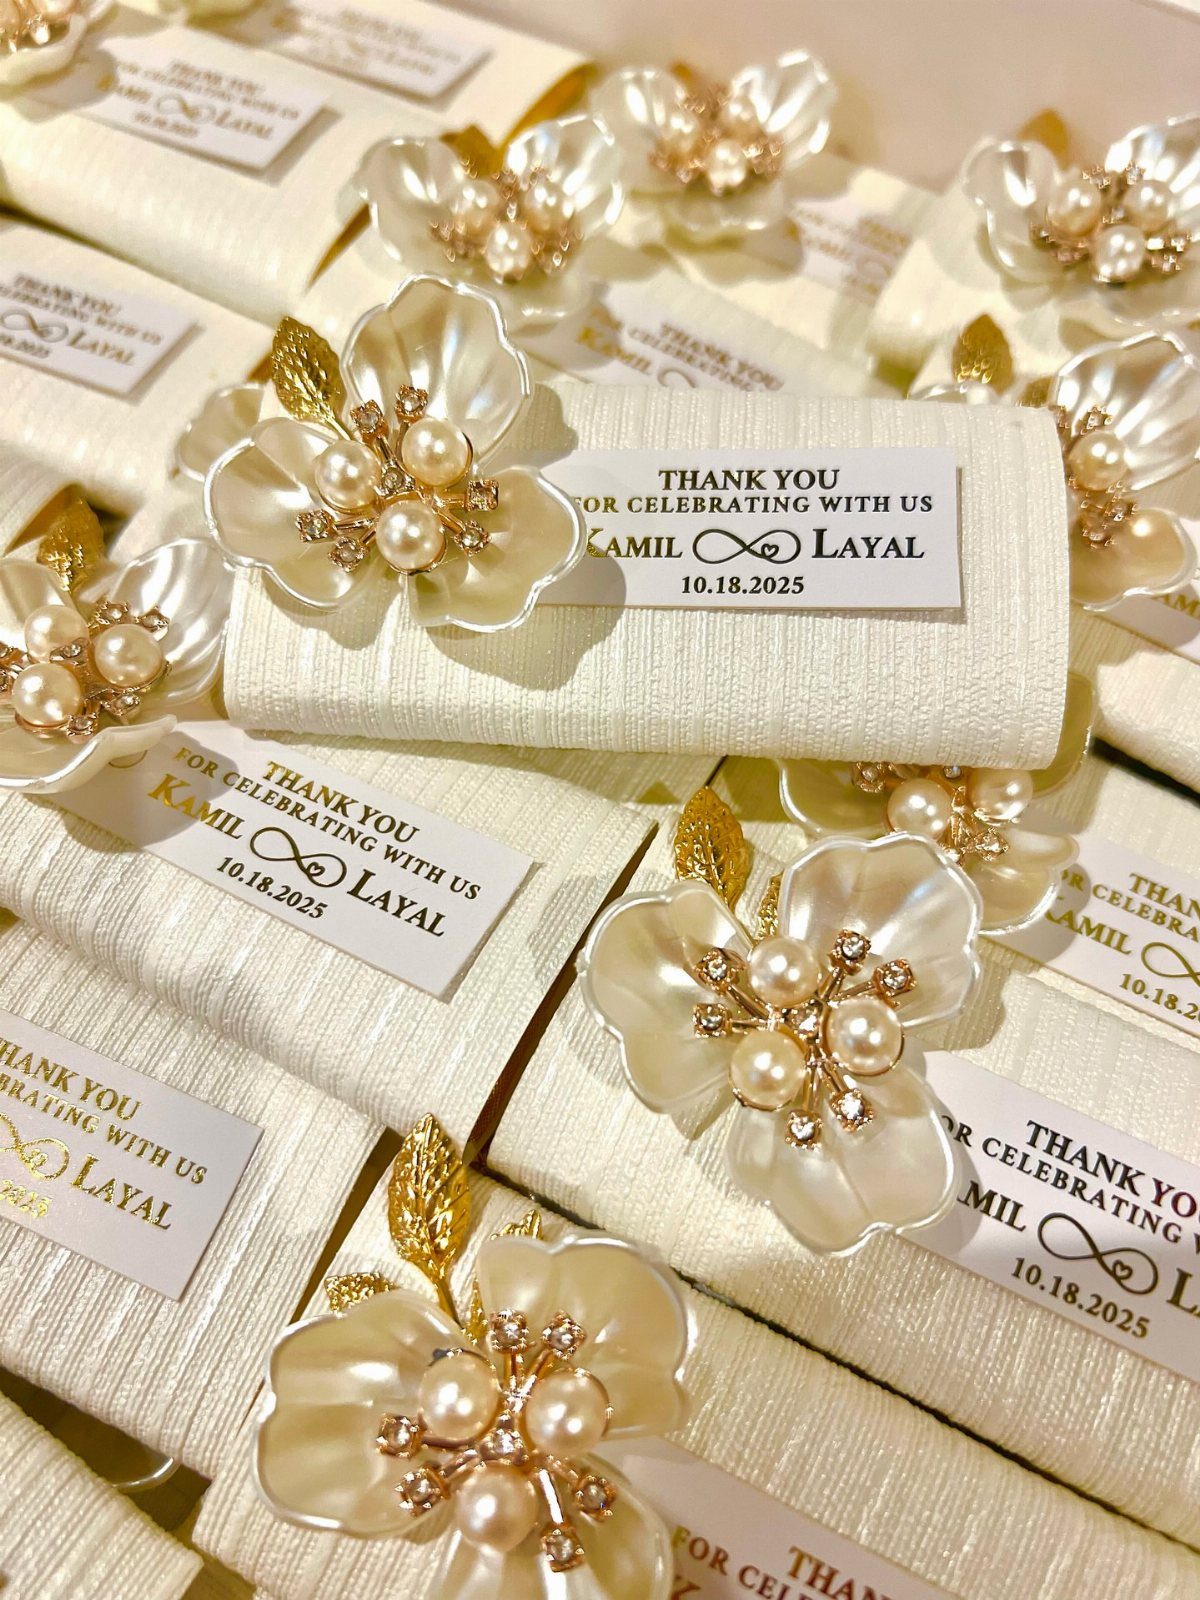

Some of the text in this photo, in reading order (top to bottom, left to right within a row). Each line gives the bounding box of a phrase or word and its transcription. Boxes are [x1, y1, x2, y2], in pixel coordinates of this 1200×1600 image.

[626, 496, 810, 514] CELEBRATING
[819, 495, 890, 513] WITH
[901, 495, 933, 513] US
[658, 468, 840, 492] THANK YOU
[811, 528, 925, 560] LAYAL
[680, 575, 805, 595] 10.18.2025
[173, 747, 483, 901] FOR CELEBRATING WITH US
[263, 760, 421, 844] THANK YOU
[147, 772, 446, 938] KAMIL LAYAL
[216, 856, 329, 920] 10.18.2025
[1092, 884, 1200, 943] CELEBRA
[1119, 973, 1200, 1021] 10.18.2
[0, 1037, 142, 1121] HANK YOU
[106, 1123, 172, 1168] WITH
[175, 1156, 208, 1185] US
[1026, 1119, 1200, 1223] THANK YO
[70, 1153, 173, 1231] LAYAL
[956, 1179, 1027, 1232] MIL
[981, 1137, 1182, 1245] CELEBRATING
[1010, 1256, 1150, 1339] 10.18.2025
